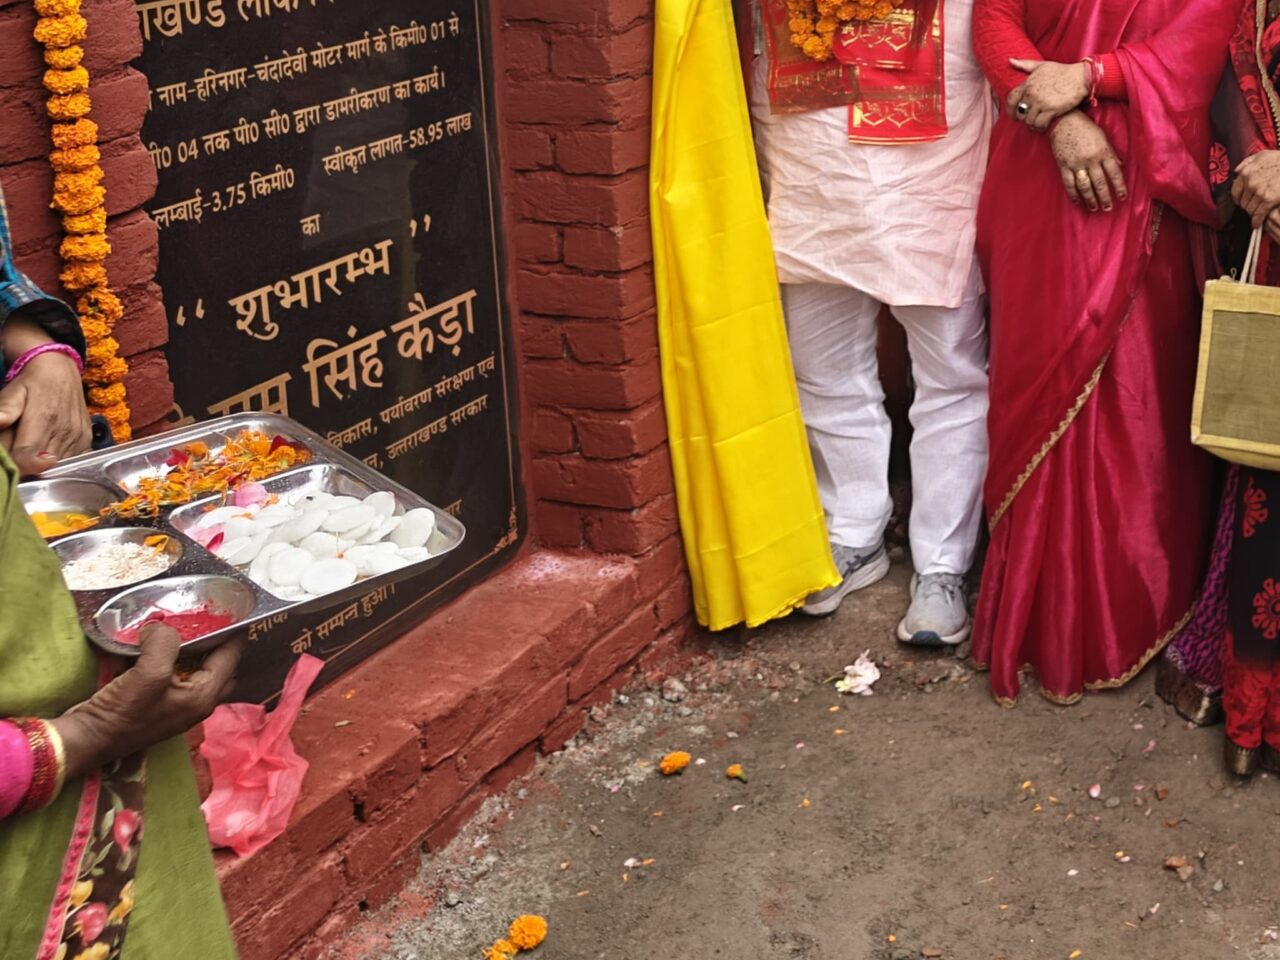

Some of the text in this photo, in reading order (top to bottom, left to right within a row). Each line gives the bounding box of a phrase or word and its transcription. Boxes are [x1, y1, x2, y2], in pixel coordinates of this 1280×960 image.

[310, 41, 343, 70] मोटर
[345, 30, 370, 60] मार्ग
[373, 27, 388, 54] के
[430, 20, 445, 40] 01
[448, 10, 460, 37] से
[177, 138, 199, 164] 04
[202, 130, 230, 156] तक
[293, 104, 321, 134] द्वारा
[323, 87, 391, 122] डामरीकरण
[393, 79, 411, 101] का
[322, 145, 367, 177] स्वीकृत
[445, 112, 472, 137] लाख
[300, 213, 321, 237] का
[227, 239, 394, 341] शुभारम्भ
[302, 324, 387, 409] सिंह
[391, 288, 478, 359] कैड़ा
[379, 395, 432, 425] पर्यावरण
[434, 365, 475, 398] संरक्षण
[477, 351, 496, 379] एवं
[385, 415, 448, 461] उत्तराखण्ड
[450, 394, 488, 427] सरकार
[290, 628, 313, 656] को
[315, 601, 360, 640] सम्पन्न
